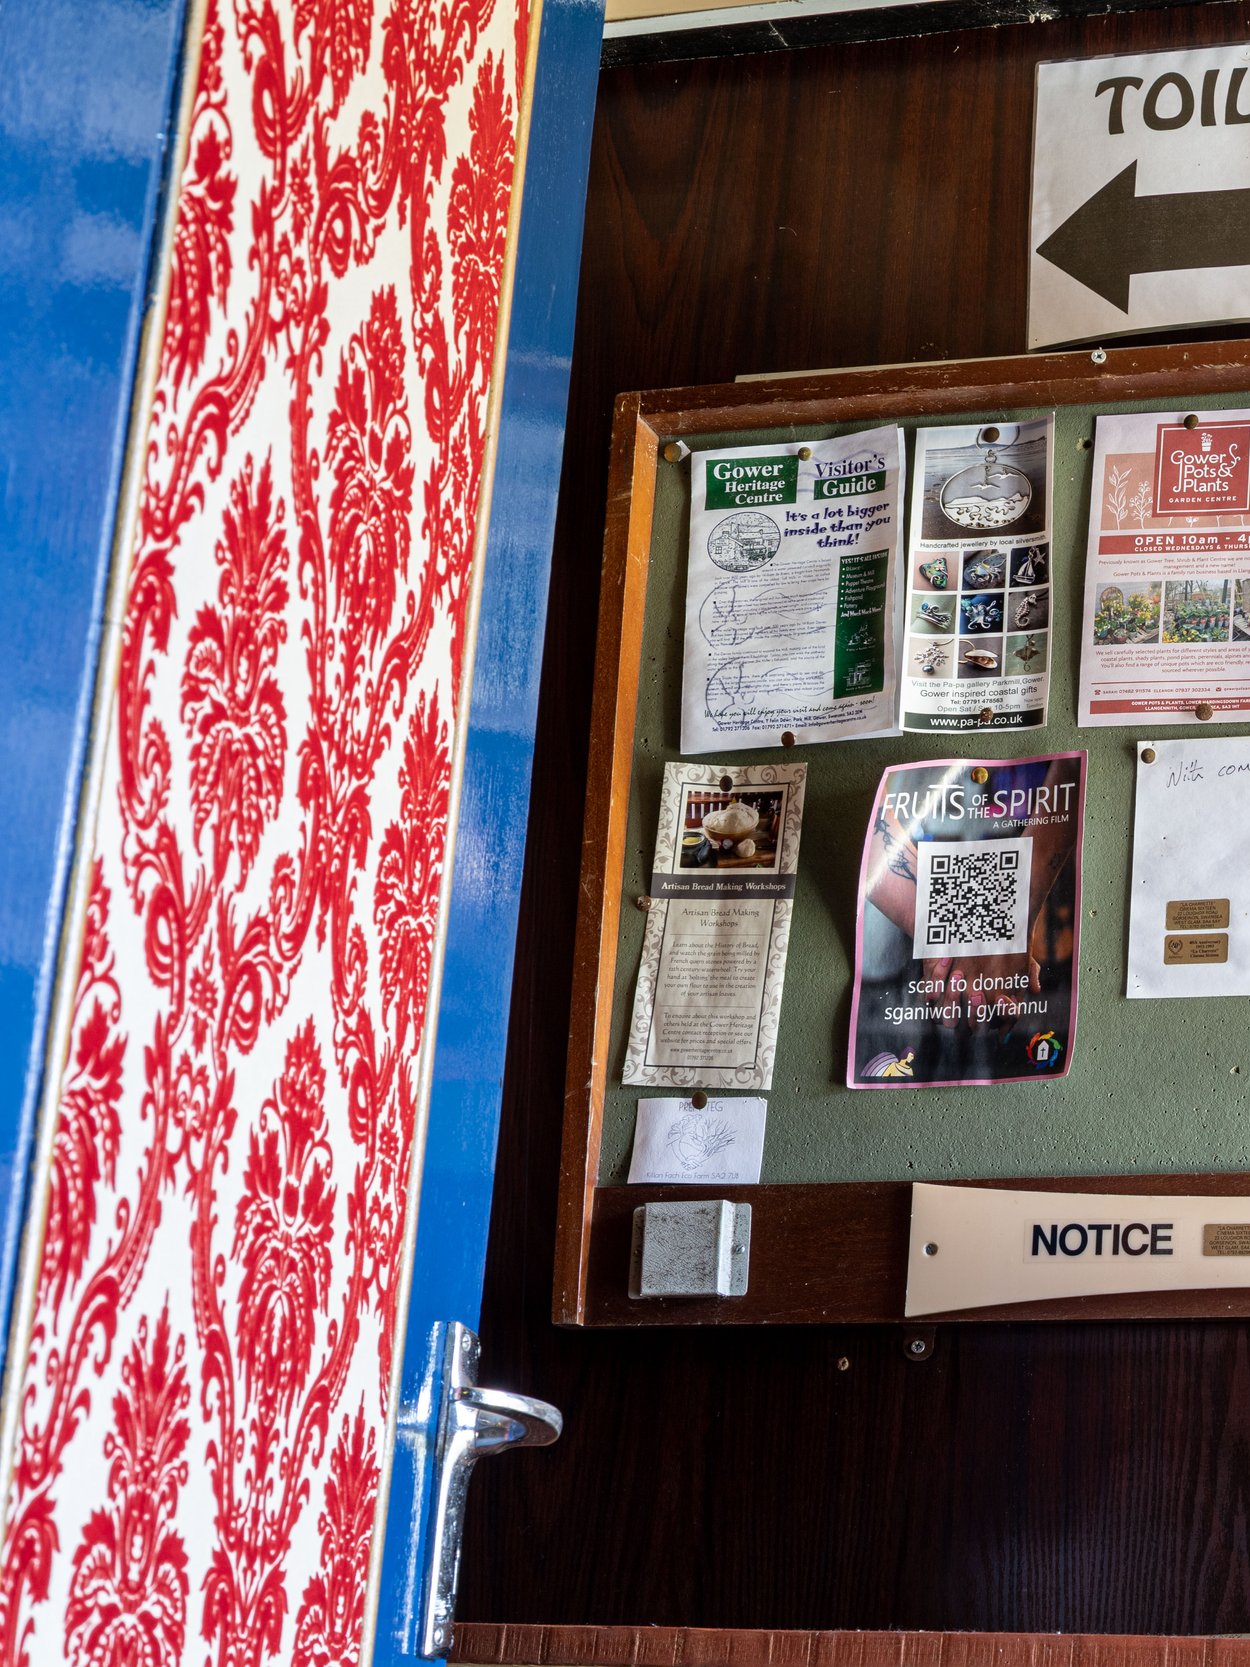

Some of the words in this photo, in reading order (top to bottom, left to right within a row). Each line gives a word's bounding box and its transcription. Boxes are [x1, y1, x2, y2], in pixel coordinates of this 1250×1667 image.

[714, 463, 783, 479] Gower
[815, 454, 885, 478] Visitor's
[1184, 464, 1216, 478] Pots
[725, 480, 785, 493] Heritage
[822, 478, 877, 496] Guide
[1183, 478, 1229, 492] Plants
[735, 492, 783, 505] Centre
[786, 511, 807, 522] It's
[824, 507, 844, 519] lot
[847, 503, 889, 519] bigger
[784, 522, 827, 537] inside
[830, 520, 862, 532] than
[865, 516, 890, 532] you
[816, 533, 860, 548] think!
[920, 541, 959, 549] Handcrafted
[960, 540, 988, 549] jewellery
[1015, 534, 1046, 544] silversmith
[1135, 535, 1175, 546] OPEN
[1182, 535, 1218, 545] 10am
[943, 681, 964, 689] Pa-pa
[966, 680, 990, 689] gallery
[952, 690, 986, 699] inspired
[989, 687, 1018, 696] coastal
[1021, 686, 1037, 696] gifts
[880, 776, 965, 822] FRUITS
[972, 794, 988, 806] OF
[992, 782, 1076, 819] SPIRIT
[967, 807, 990, 820] THE
[992, 821, 999, 829] A
[1001, 817, 1049, 828] GATHERING
[1050, 814, 1069, 824] FILM
[662, 882, 690, 890] Artisan
[716, 883, 742, 891] Making
[745, 882, 786, 891] Workshops
[682, 908, 709, 916] Artisan
[732, 908, 759, 917] Making
[700, 920, 738, 928] Workshops
[908, 977, 944, 994] scan
[950, 977, 967, 992] to
[973, 973, 1030, 991] donate
[884, 1001, 962, 1025] sganiwch
[967, 1001, 971, 1018] i
[976, 999, 1048, 1023] gyfrannu
[706, 1101, 723, 1112] TEG
[1032, 1223, 1174, 1256] NOTICE
